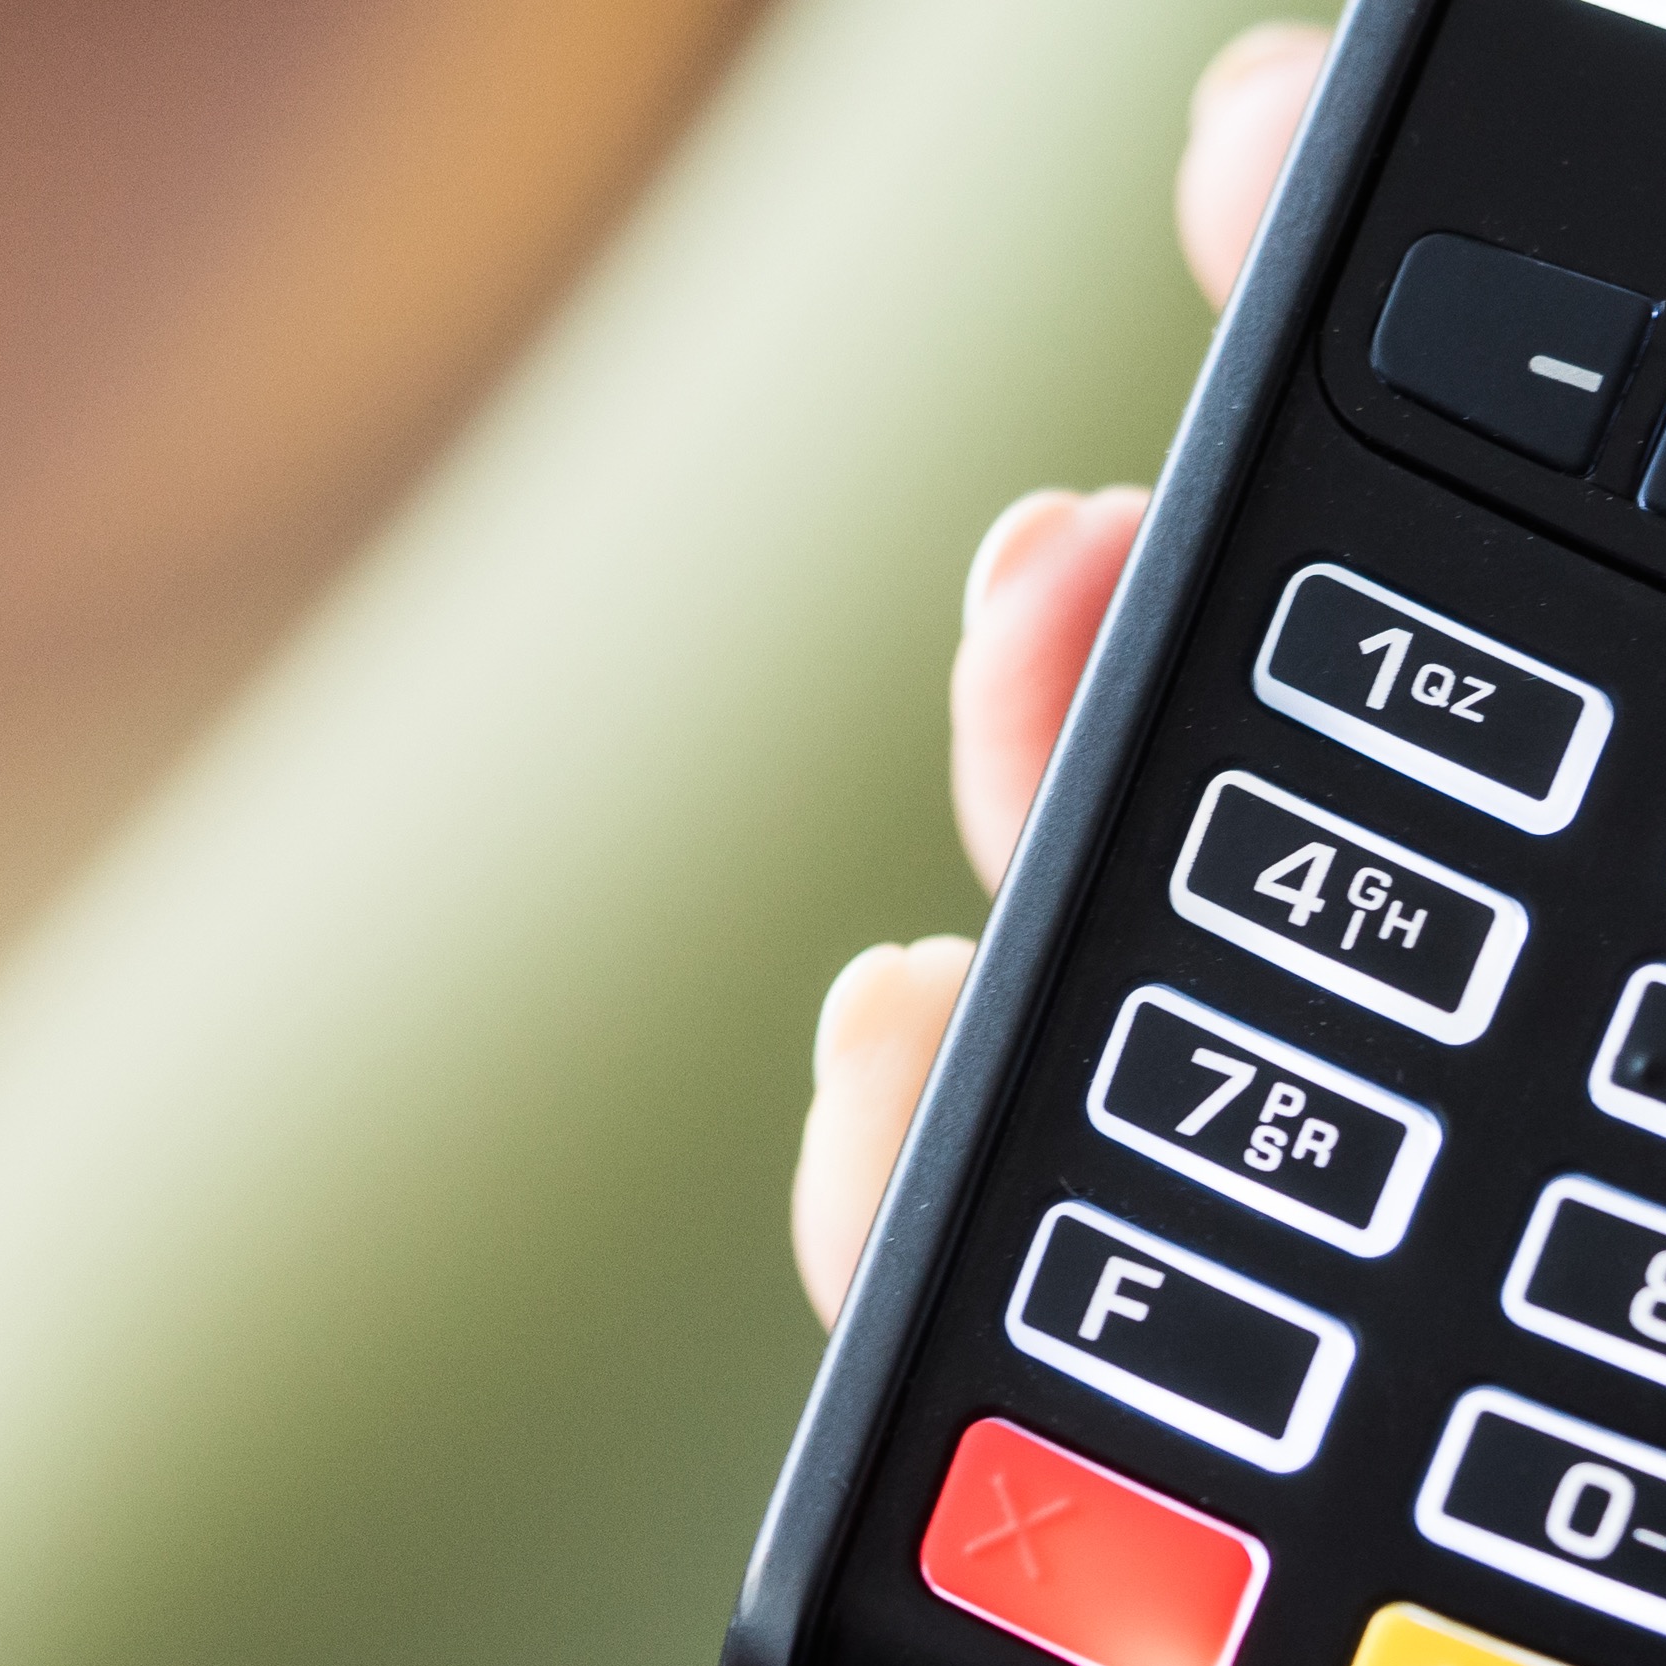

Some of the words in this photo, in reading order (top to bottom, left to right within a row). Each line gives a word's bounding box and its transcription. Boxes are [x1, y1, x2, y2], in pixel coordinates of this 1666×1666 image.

[1359, 628, 1413, 710] 1
[1254, 842, 1337, 926] 4
[1175, 1048, 1257, 1136] 7
[1078, 1256, 1165, 1341] F
[1545, 1462, 1635, 1559] 0
